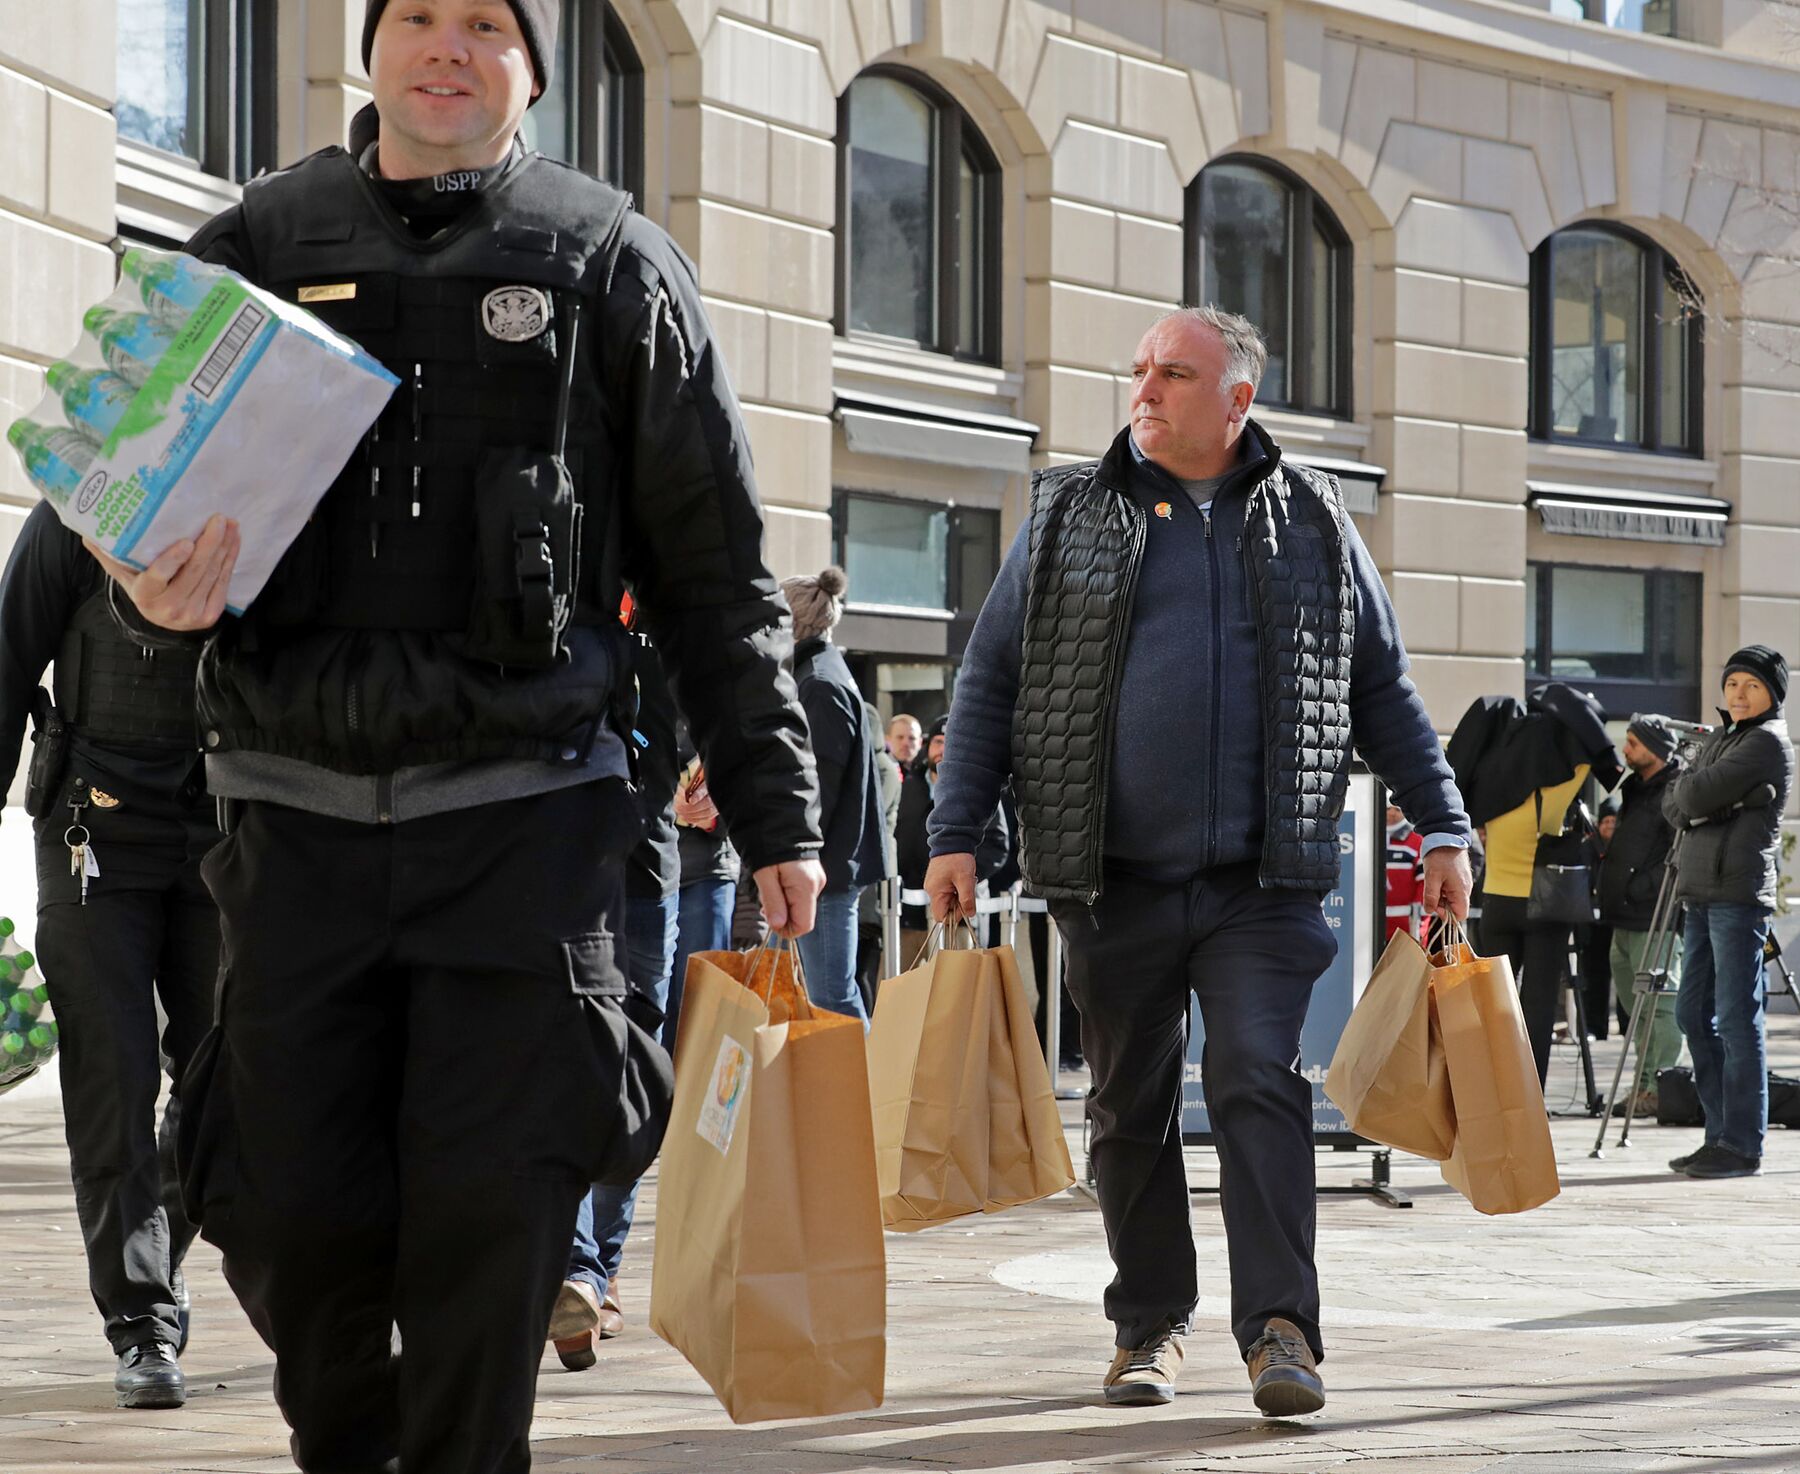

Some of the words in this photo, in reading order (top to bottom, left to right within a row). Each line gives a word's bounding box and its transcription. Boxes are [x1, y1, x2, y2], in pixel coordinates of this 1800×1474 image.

[432, 171, 481, 192] USPP
[94, 480, 123, 518] 100%
[95, 473, 140, 538] COCONUT
[108, 489, 146, 537] WATER
[1330, 893, 1344, 907] in
[1340, 1120, 1350, 1131] ID
